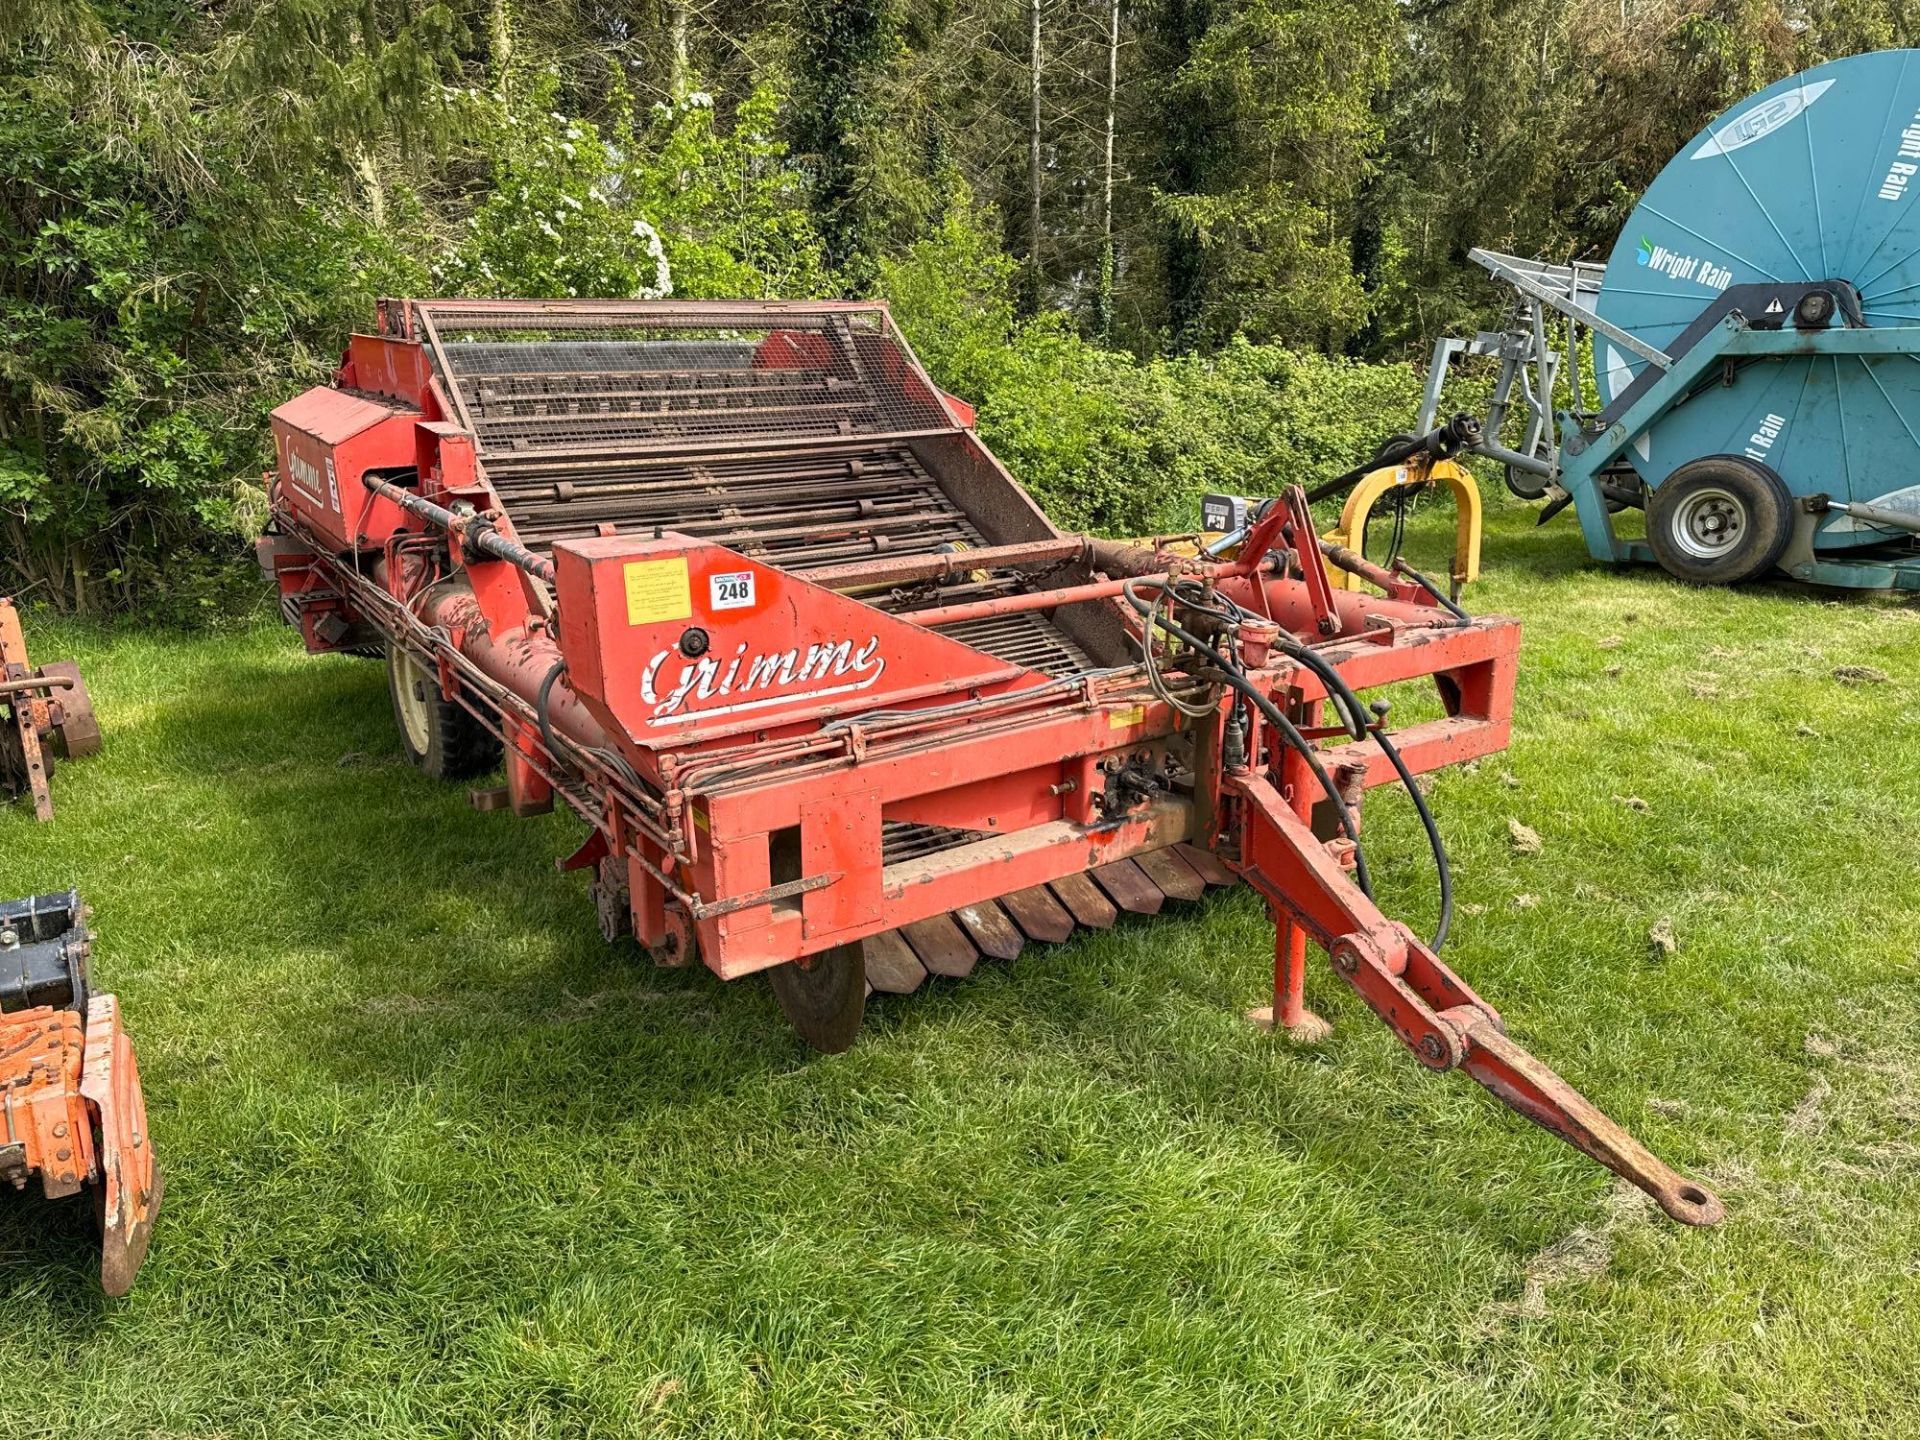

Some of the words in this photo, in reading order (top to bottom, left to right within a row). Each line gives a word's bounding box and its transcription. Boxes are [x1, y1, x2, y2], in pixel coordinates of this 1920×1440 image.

[1877, 161, 1919, 201] Rain
[1648, 245, 1700, 280] Wright
[1696, 260, 1733, 291] Rain
[1750, 413, 1786, 449] Rain
[718, 581, 749, 601] 248
[641, 634, 885, 721] Grimme
